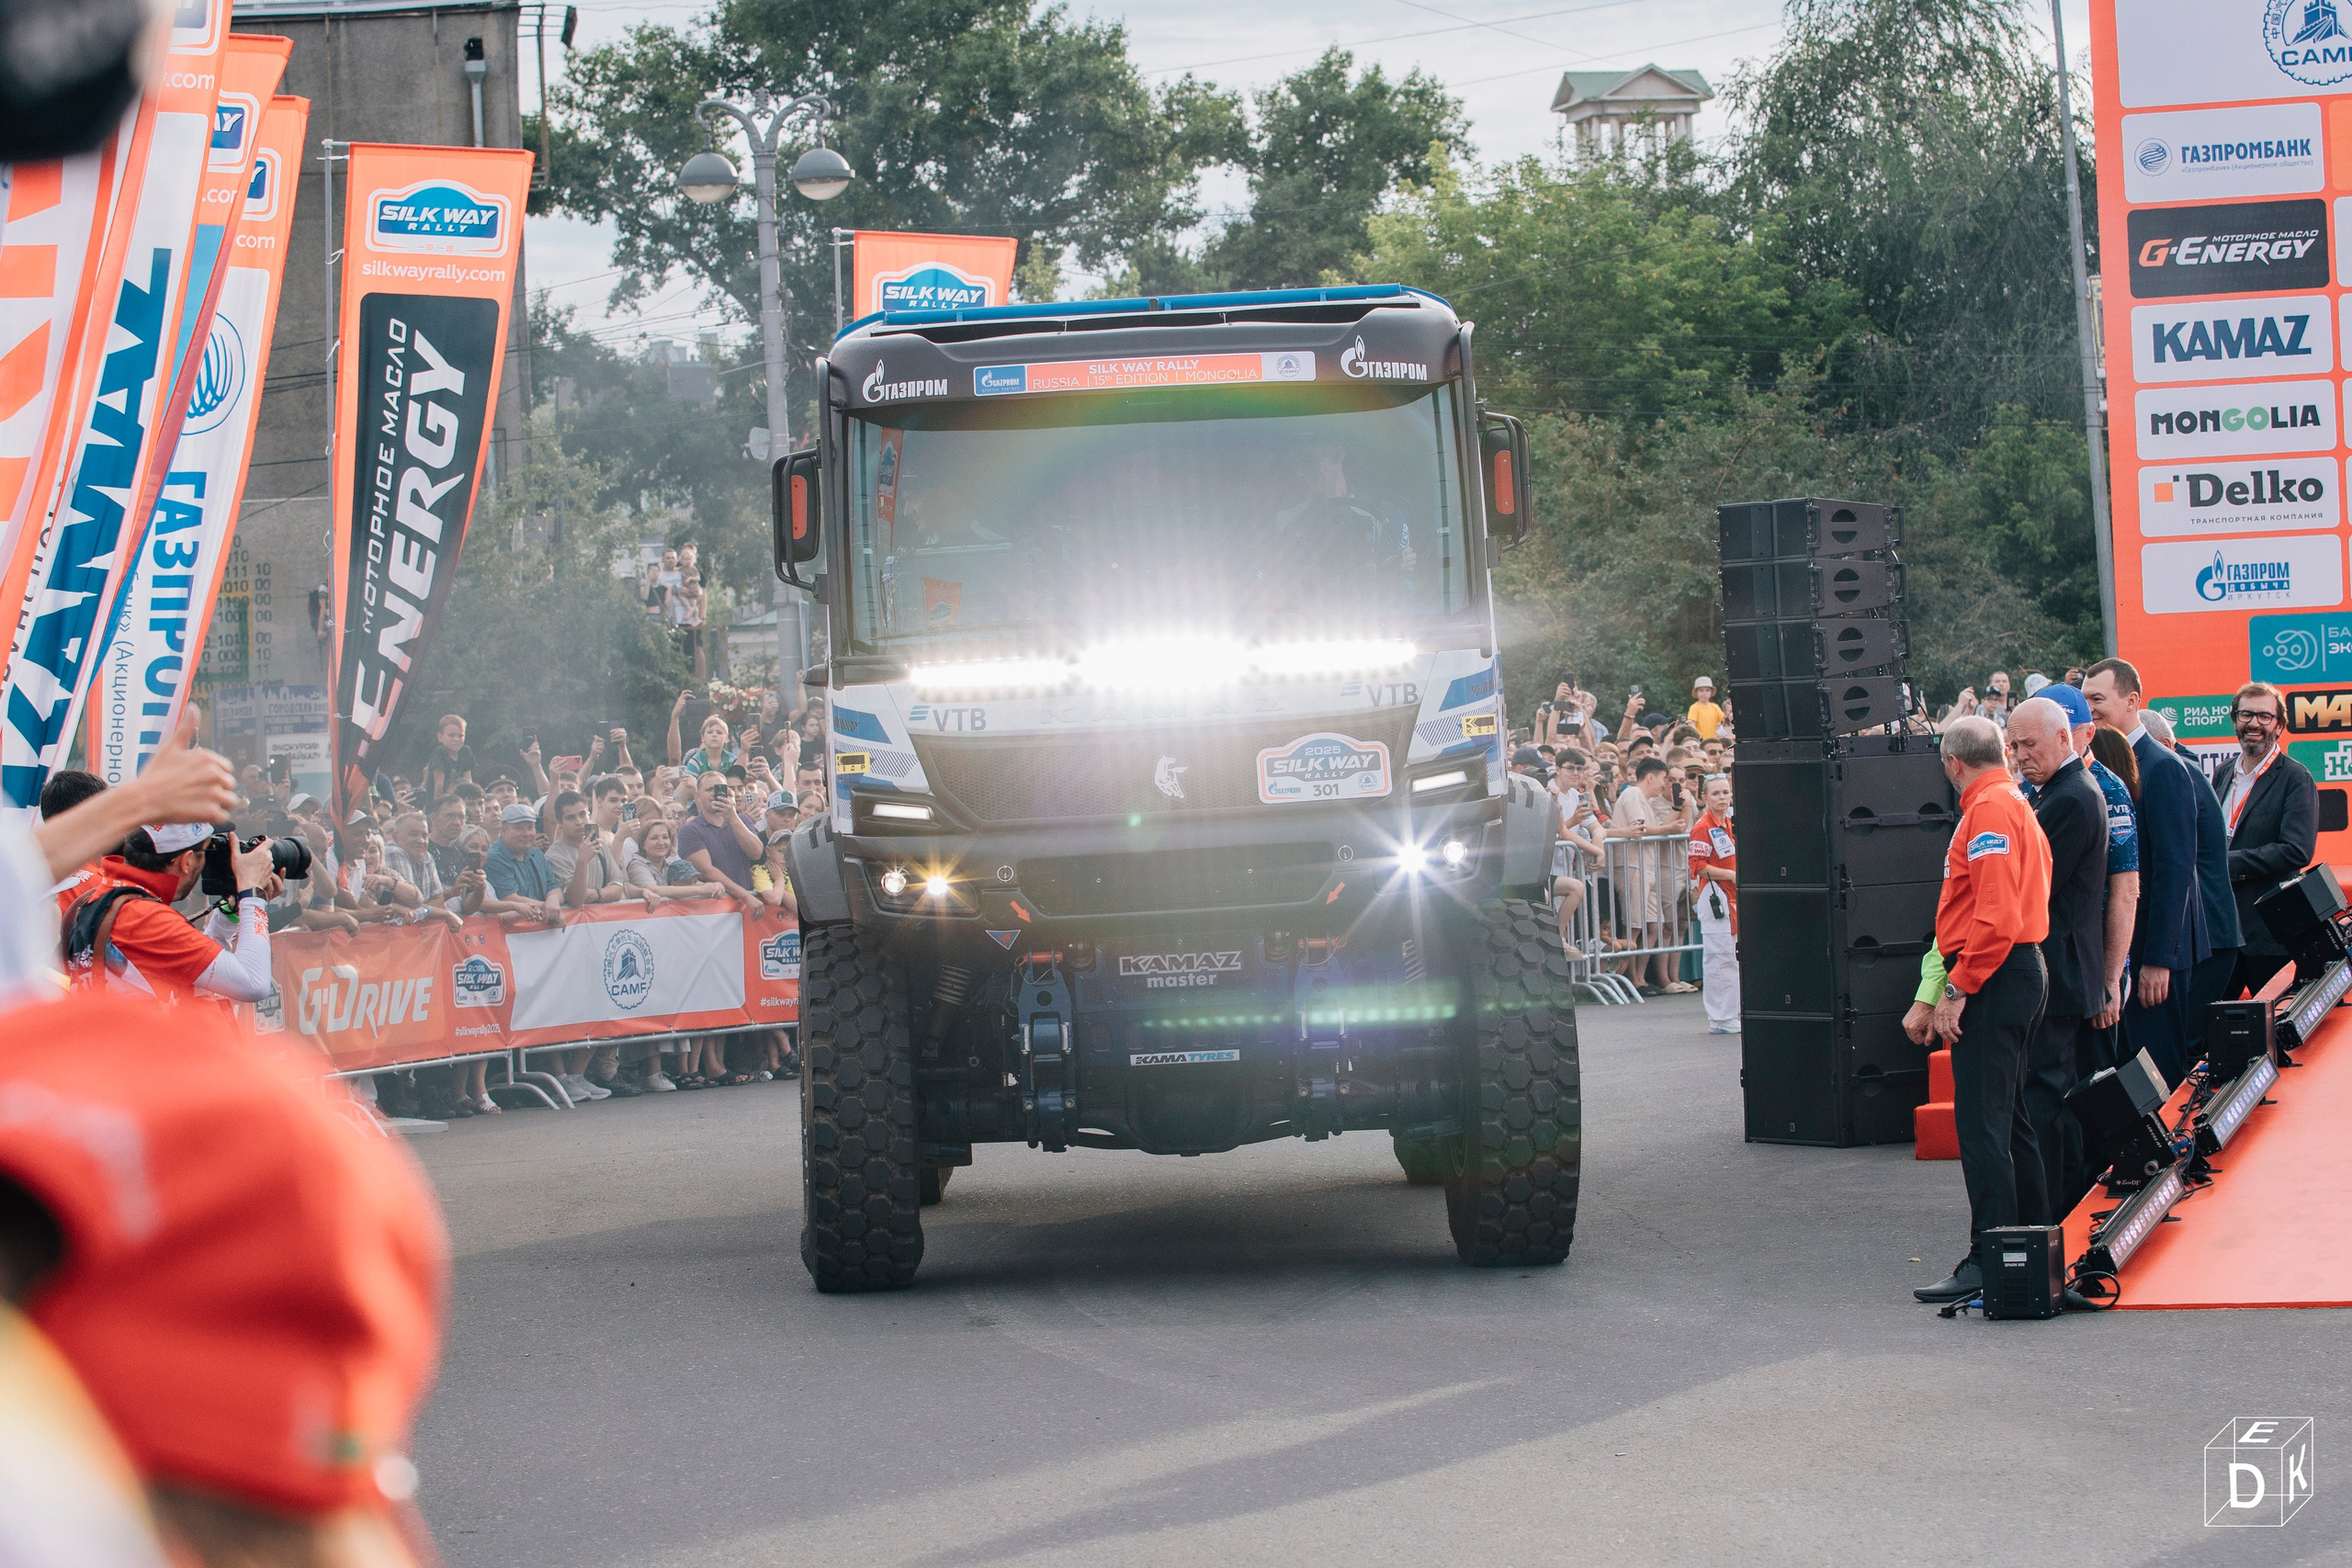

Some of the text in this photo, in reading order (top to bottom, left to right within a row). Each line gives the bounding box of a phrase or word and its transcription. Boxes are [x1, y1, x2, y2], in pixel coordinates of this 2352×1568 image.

[2181, 138, 2312, 164] ГАЗПРОМБАНК
[379, 205, 497, 226] SILK WAY
[408, 223, 469, 233] RALLY
[2211, 230, 2320, 243] МОТОРНОЕ МАСЛО
[362, 260, 505, 284] silkwayrally.com
[884, 286, 985, 303] SILK WAY
[909, 300, 960, 310] RALLY
[2153, 314, 2312, 363] KAMAZ
[1089, 359, 1200, 374] SILK WAY RALLY
[1369, 362, 1428, 380] ГАЗПРОМ
[992, 378, 1020, 388] GAZPROM
[1033, 369, 1258, 389] RUSSIA 15th EDITION MONGOLIA
[885, 378, 948, 400] ГАЗПРОМ
[2150, 405, 2321, 435] MONGOLIA
[362, 318, 407, 634] МОТОРНОЕ МАСЛО
[2186, 469, 2324, 508] Delko
[2190, 513, 2324, 525] ТРАНСПОРТНАЯ КОМПАНИЯ
[2227, 562, 2290, 581] ГАЗПРОМ
[2229, 581, 2289, 592] ДОБЫЧА
[2228, 592, 2290, 601] ИРКУТСК
[2328, 642, 2352, 654] ЭК
[1366, 682, 1419, 707] VTB
[2184, 706, 2209, 716] РИА
[933, 707, 988, 732] VTB
[2184, 716, 2224, 727] СПОРТ
[1305, 746, 1341, 755] 2025
[1272, 754, 1375, 774] SILK WAY
[1305, 771, 1346, 779] RALLY
[1313, 783, 1340, 797] 301
[1971, 840, 1985, 851] SILK
[765, 947, 791, 958] SILK
[1119, 951, 1242, 976] KAMAZ
[458, 973, 499, 985] SILK WAY
[1147, 974, 1217, 988] master
[612, 983, 647, 996] CAMF
